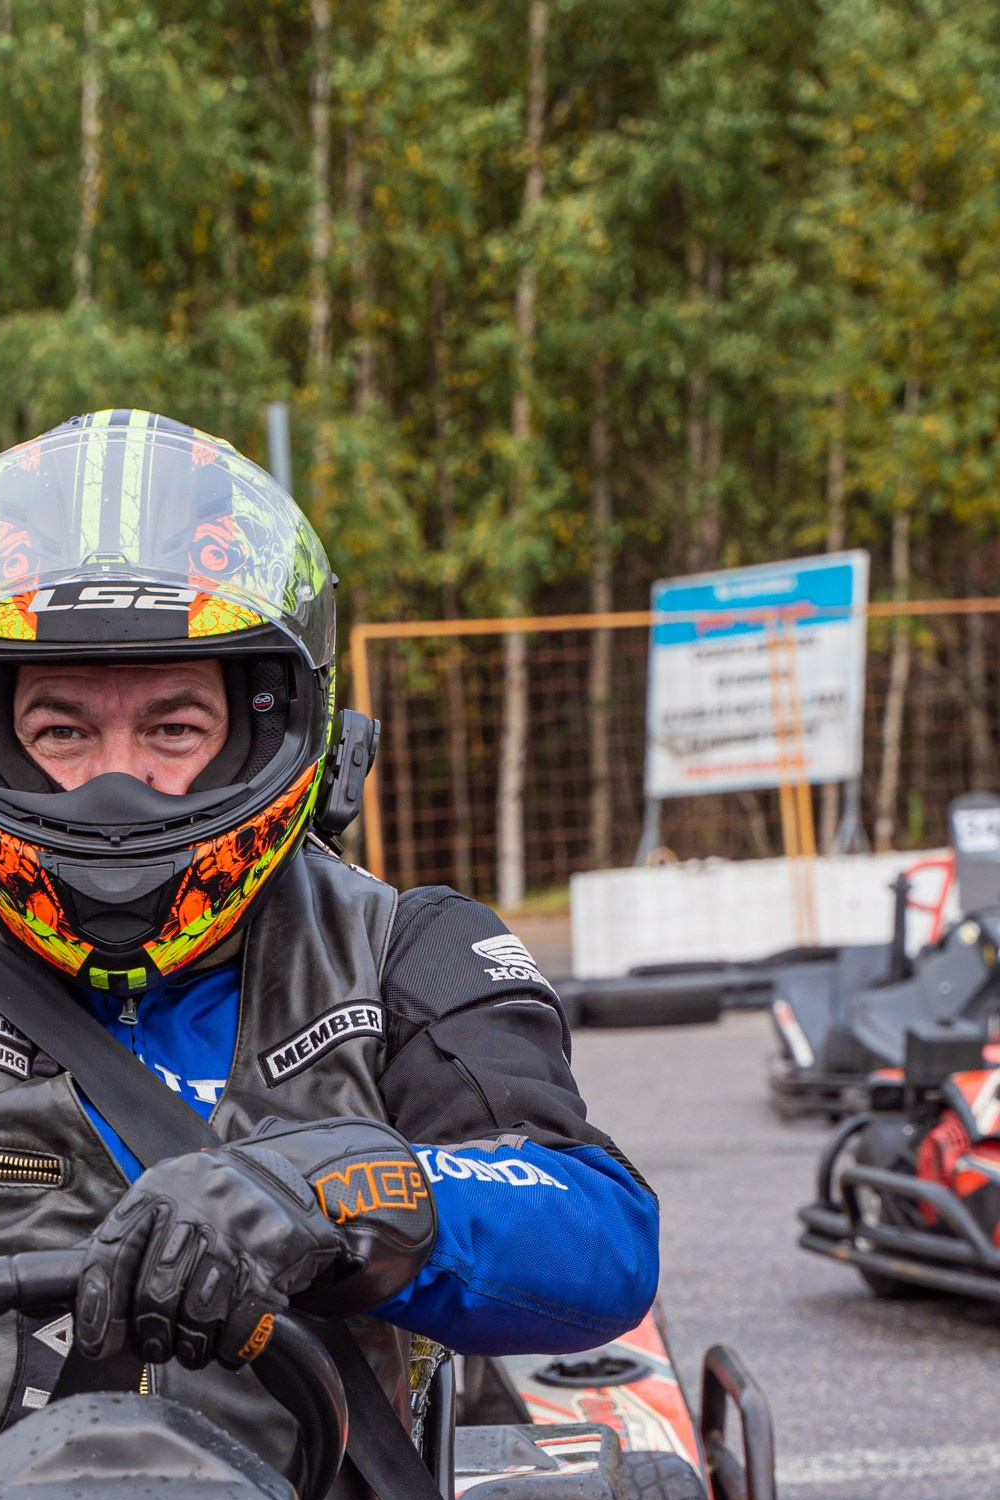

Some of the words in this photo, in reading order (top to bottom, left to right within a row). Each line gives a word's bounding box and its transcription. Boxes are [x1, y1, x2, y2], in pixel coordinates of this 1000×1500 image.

[28, 586, 198, 613] LS2
[273, 1009, 380, 1073] MEMBER
[316, 1161, 429, 1224] MCP
